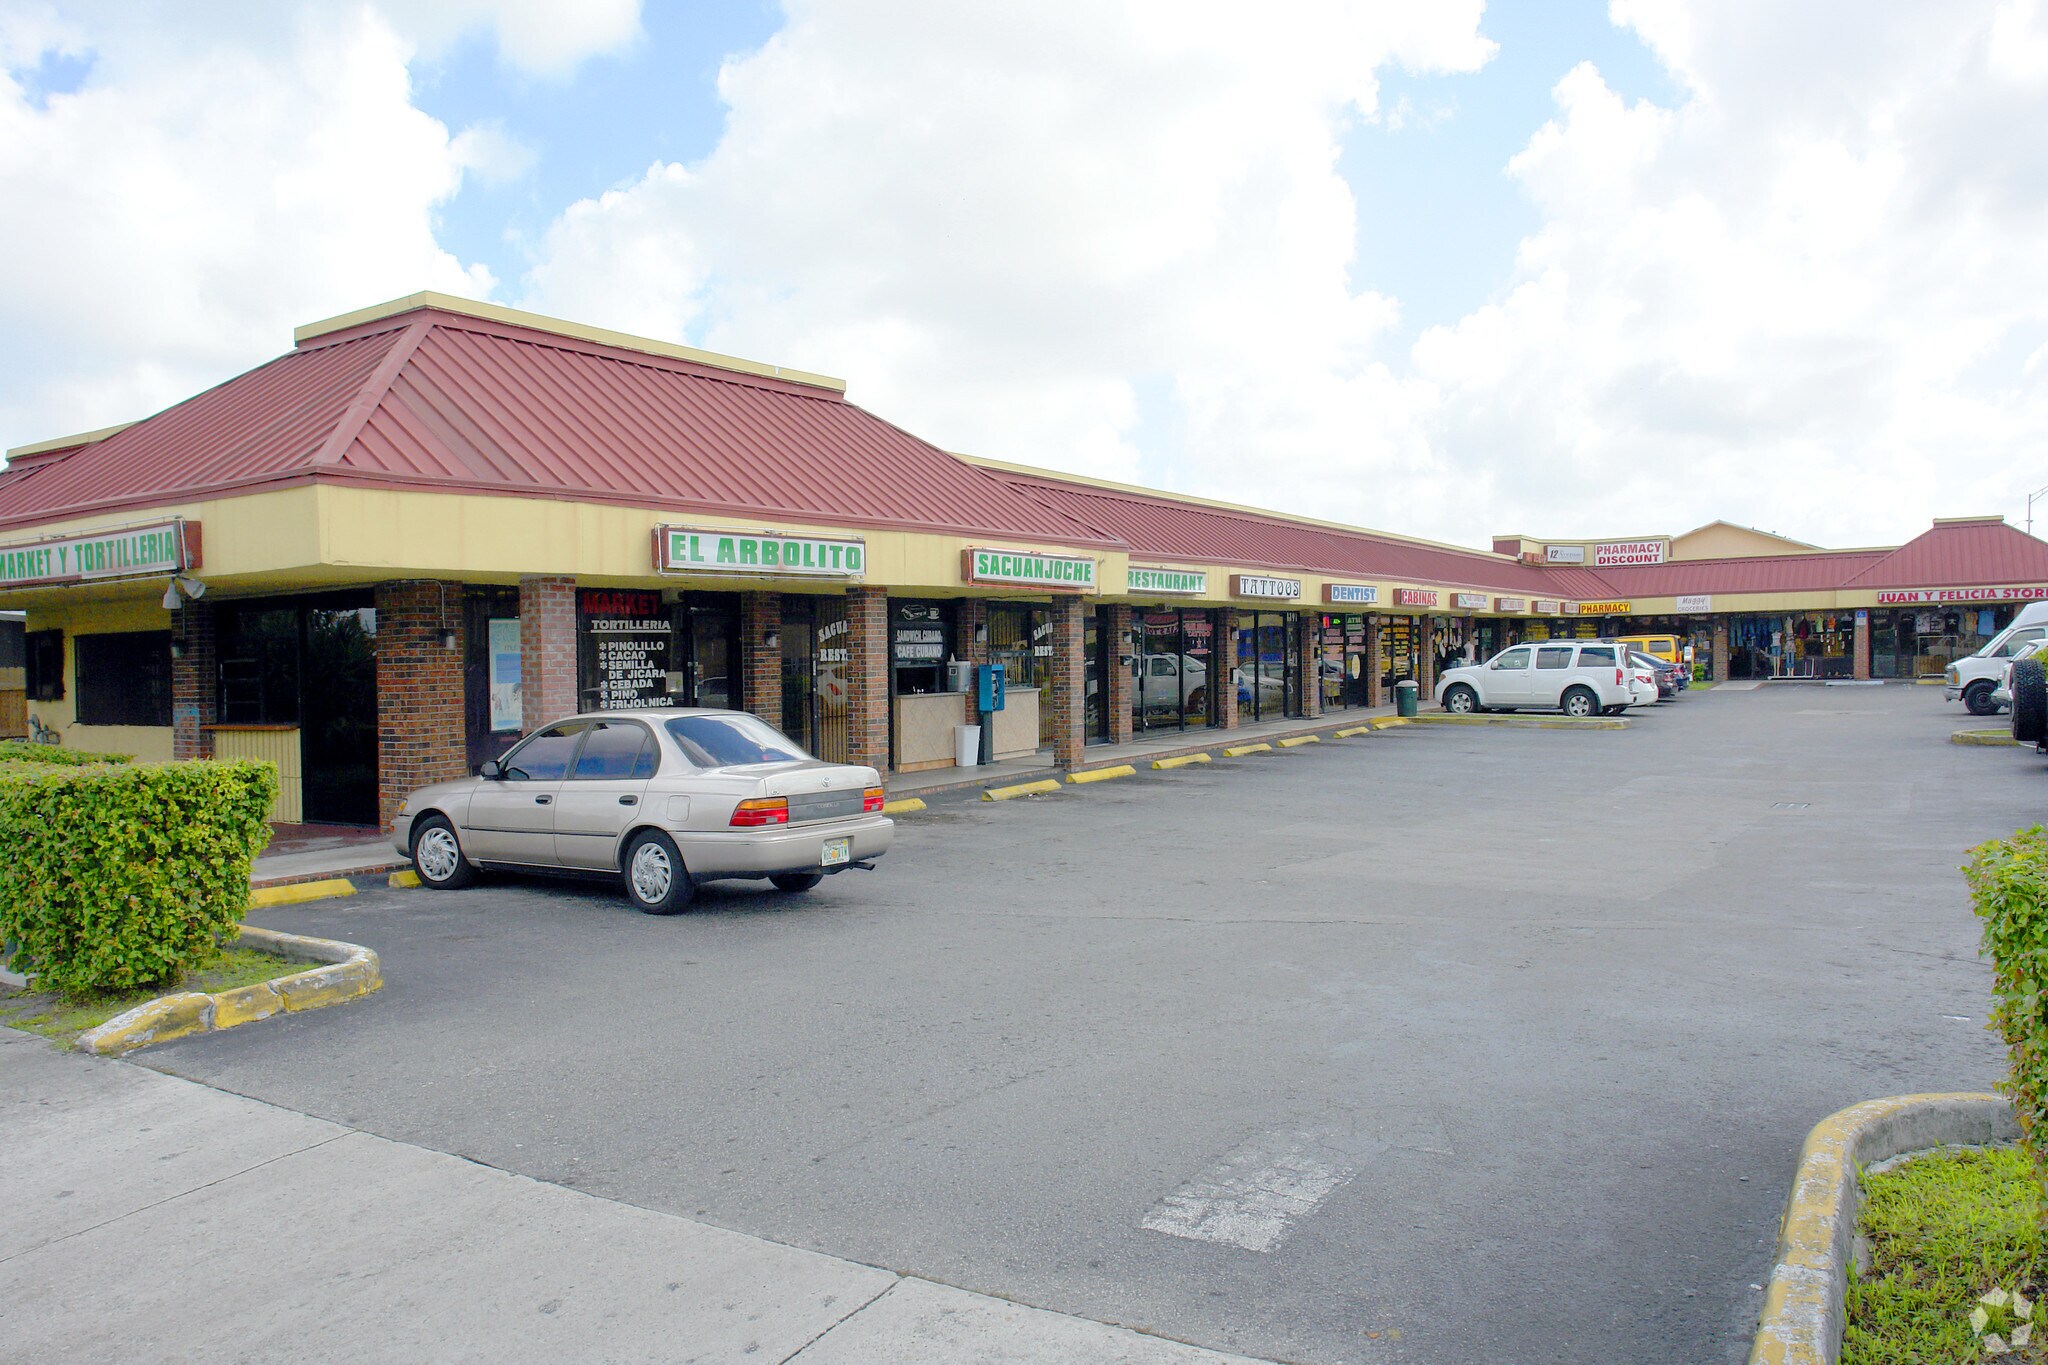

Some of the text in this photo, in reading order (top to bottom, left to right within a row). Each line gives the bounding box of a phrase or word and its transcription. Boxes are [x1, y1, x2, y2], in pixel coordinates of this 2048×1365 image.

[58, 546, 67, 574] Y
[74, 531, 174, 572] TORTILLERIA
[671, 534, 861, 570] EL ARBOLITO
[1550, 549, 1558, 559] 12
[1596, 543, 1661, 555] PHARMACY
[1598, 554, 1660, 565] DISCOUNT
[978, 554, 1091, 582] SACUANJOCHE
[1128, 571, 1203, 591] RESTAURANT
[1241, 578, 1299, 596] TATTOOS
[1332, 586, 1376, 601] DENTIST
[1401, 590, 1437, 606] CABINAS
[1879, 587, 2048, 603] JUAN Y FELICIA STOR
[583, 591, 659, 615] MARKET
[1581, 603, 1629, 614] PHARMACY
[591, 619, 671, 630] TORTILLERIA
[608, 641, 665, 651] PINOLILLO
[897, 646, 942, 658] CAFE CUBANO
[1034, 645, 1053, 656] REST
[608, 651, 646, 660] CACAO
[820, 648, 848, 661] REST
[608, 660, 655, 670] SEMILLA
[608, 669, 667, 679] DE JICARA
[609, 679, 654, 690] CEBADA
[611, 690, 638, 700] PINO
